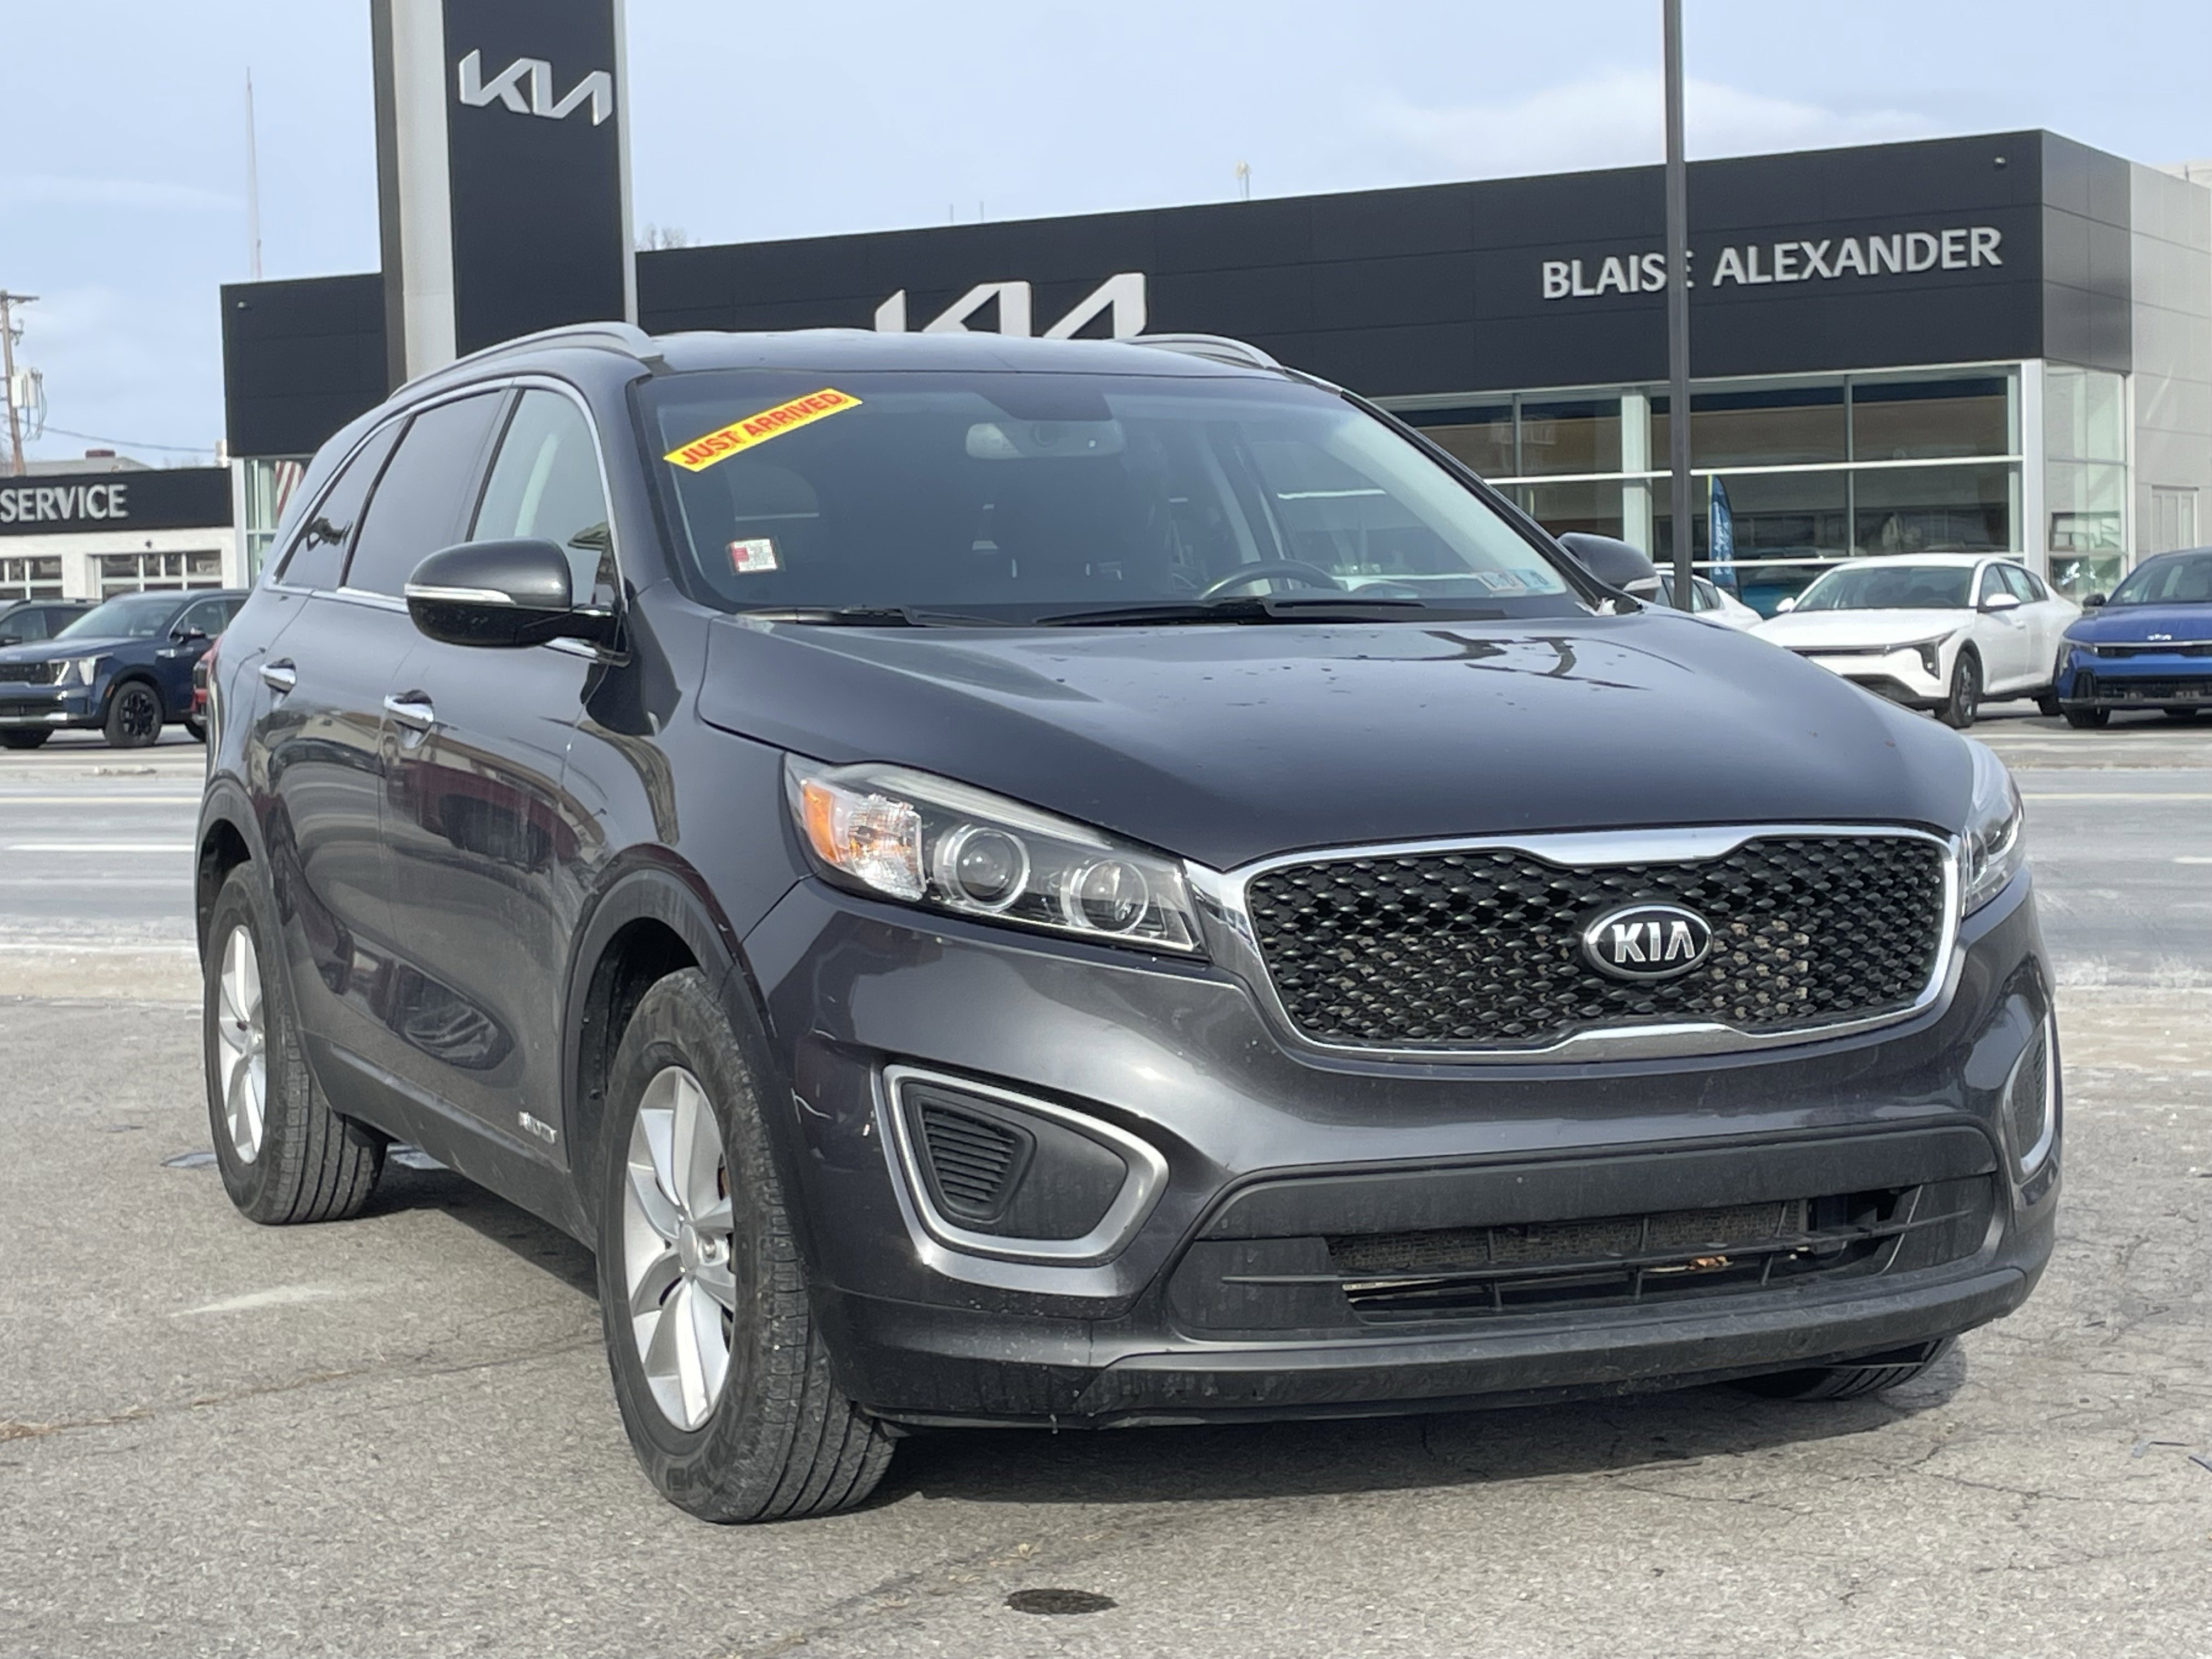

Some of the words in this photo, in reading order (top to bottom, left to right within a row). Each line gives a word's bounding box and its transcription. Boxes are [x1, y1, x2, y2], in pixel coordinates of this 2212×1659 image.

[459, 49, 613, 127] KIA
[1712, 226, 2002, 286] ALEXANDER
[681, 431, 742, 465] JUST
[742, 393, 845, 437] ARRIVED
[0, 484, 128, 522] SERVICE
[1611, 921, 1695, 963] KIA
